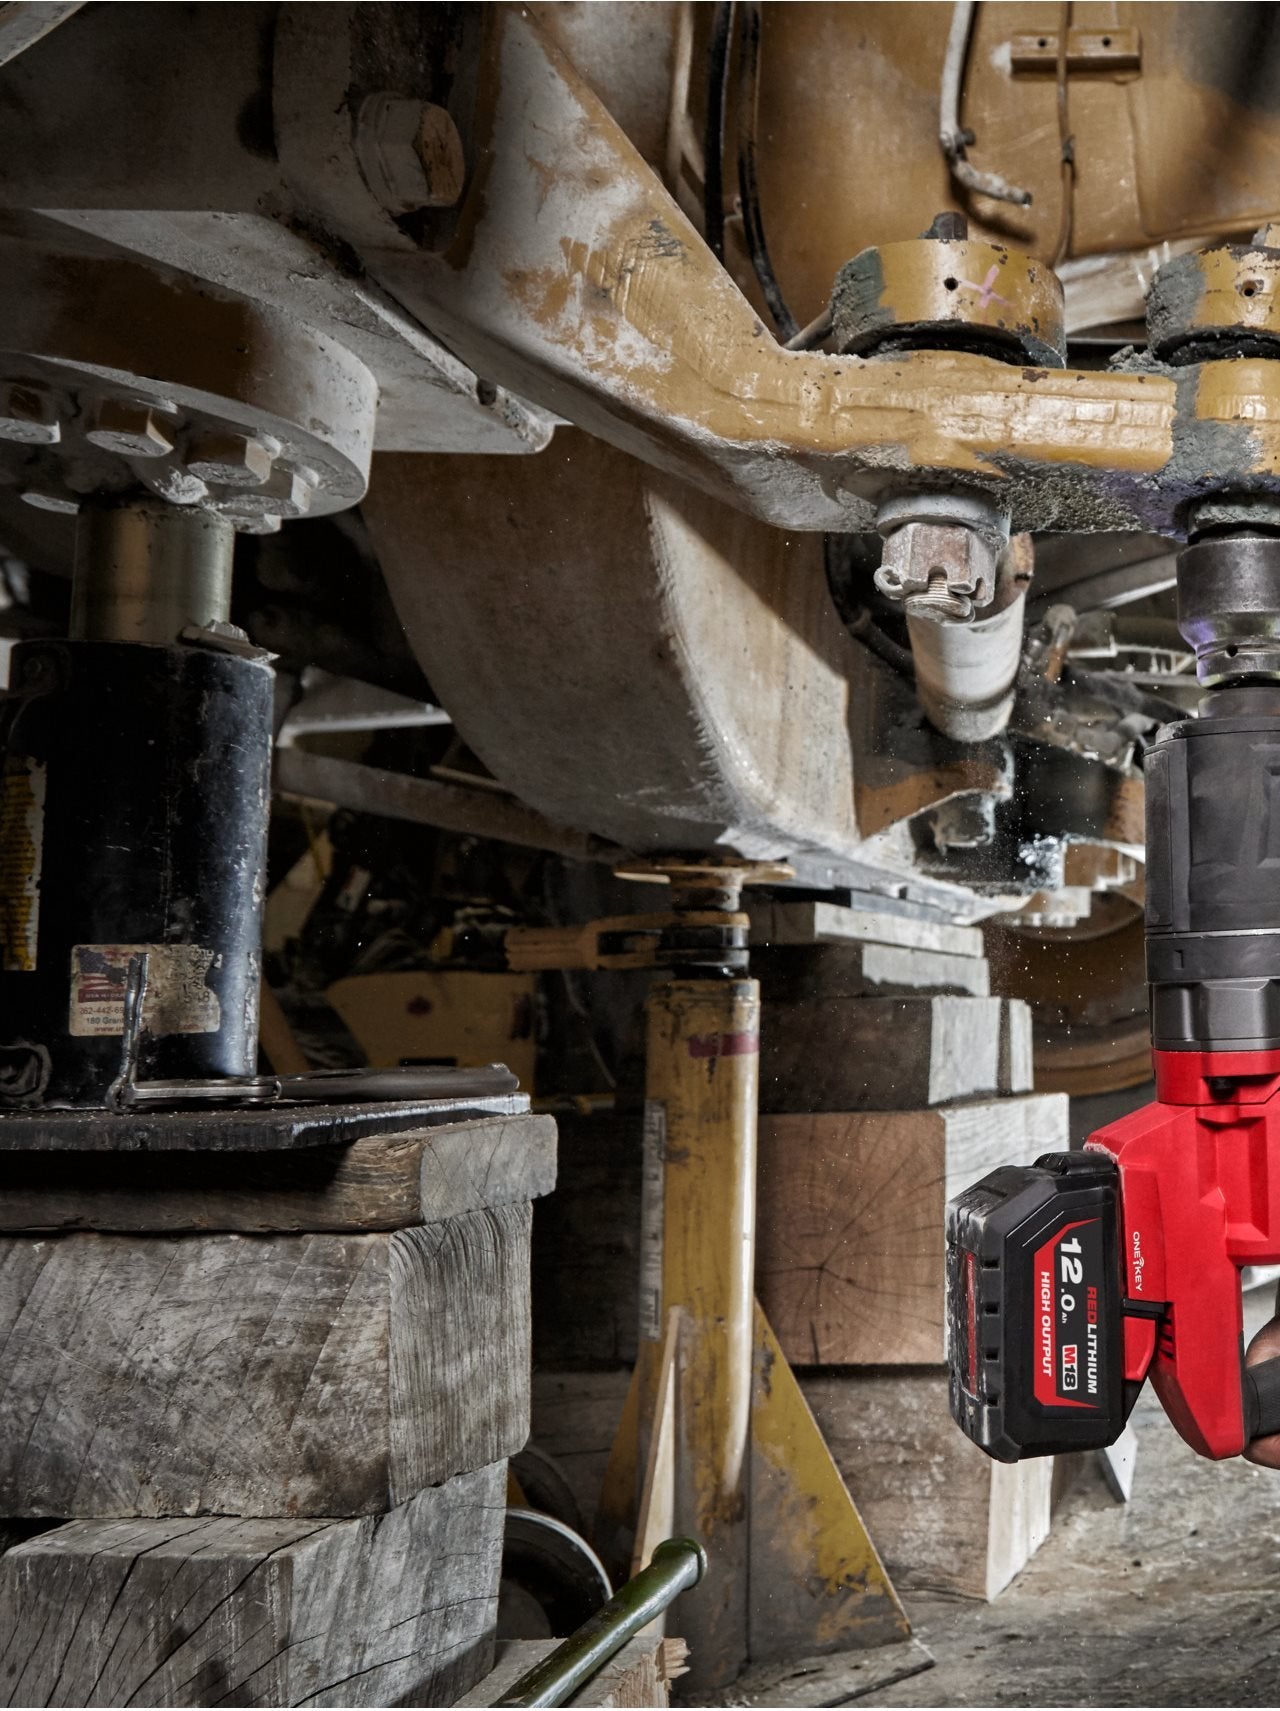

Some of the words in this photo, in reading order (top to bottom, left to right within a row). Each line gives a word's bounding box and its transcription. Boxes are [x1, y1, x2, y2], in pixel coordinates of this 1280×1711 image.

[1041, 1271, 1051, 1311] HIGH
[1041, 1314, 1052, 1377] OUTPUT
[1087, 1286, 1097, 1394] REDLITHIUM
[1064, 1346, 1077, 1388] M18
